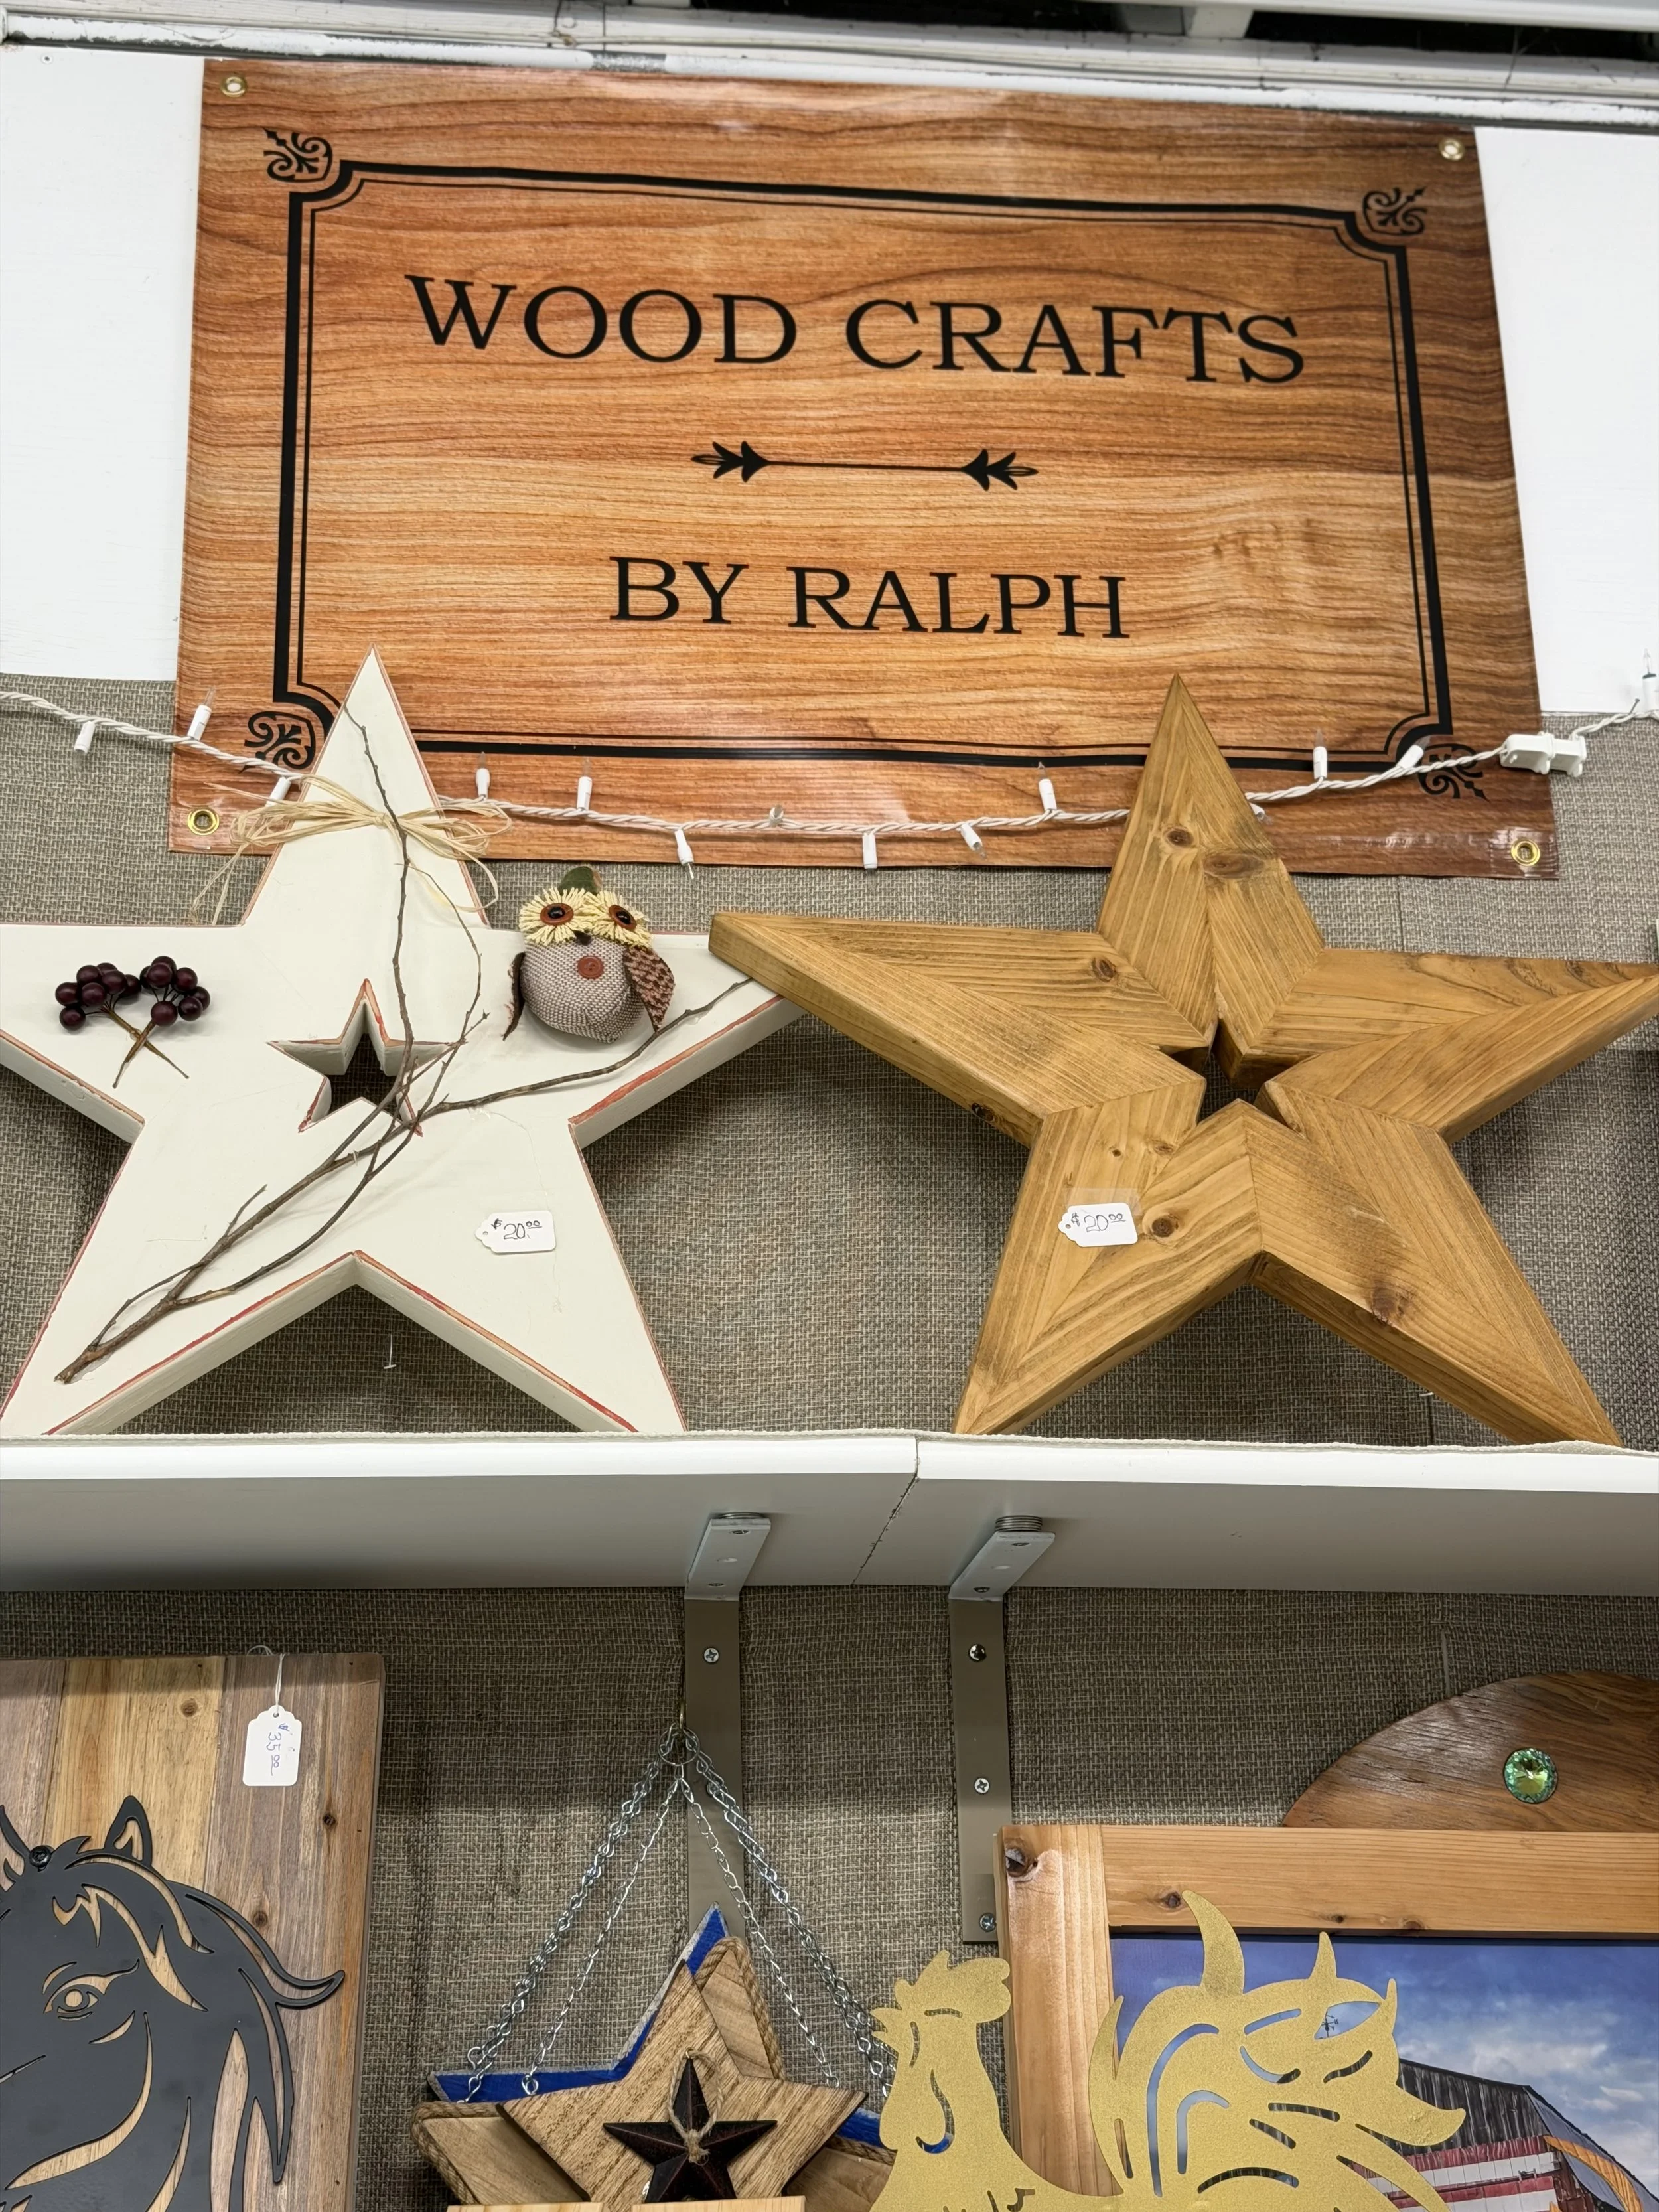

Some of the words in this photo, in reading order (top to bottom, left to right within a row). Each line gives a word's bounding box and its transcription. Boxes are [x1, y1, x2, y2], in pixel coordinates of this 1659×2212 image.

[405, 275, 796, 364] WOOD
[846, 299, 1305, 384] CRAFTS
[609, 557, 749, 624] BY
[786, 567, 1129, 638] RALPH
